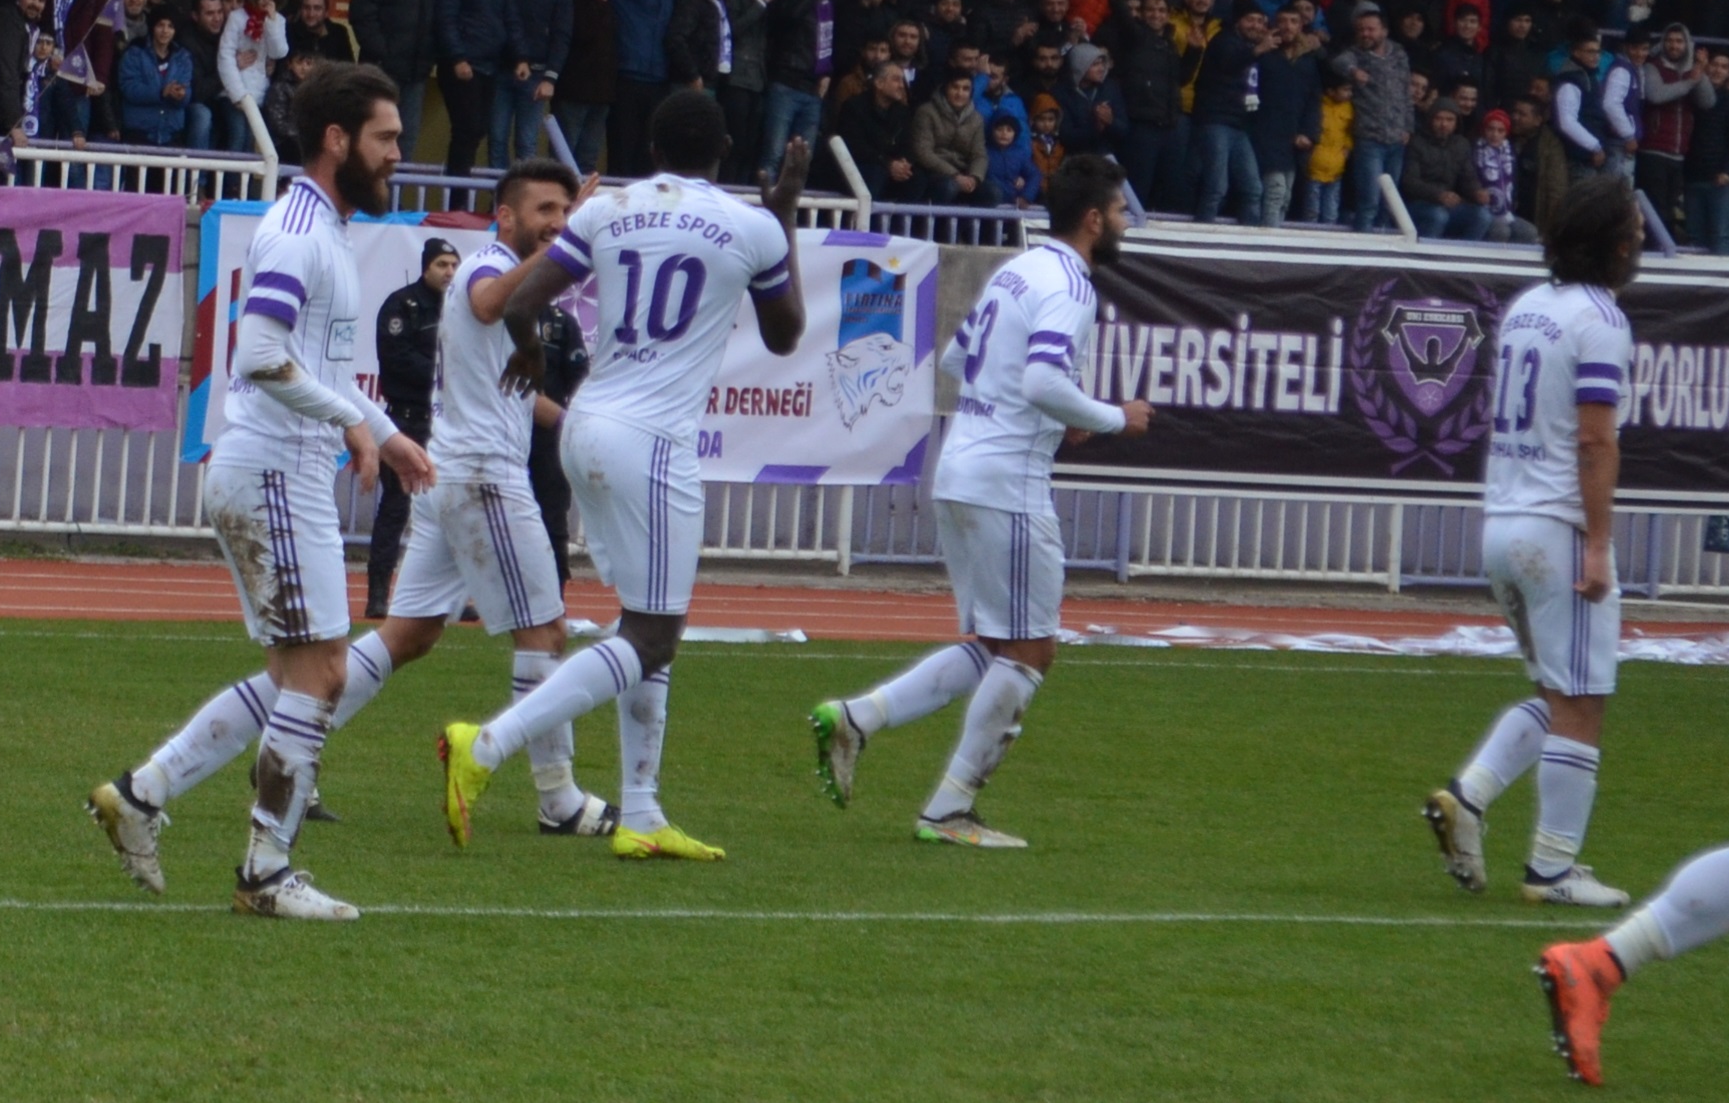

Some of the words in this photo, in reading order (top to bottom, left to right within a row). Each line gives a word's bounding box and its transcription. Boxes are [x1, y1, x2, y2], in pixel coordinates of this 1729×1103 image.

[610, 212, 671, 237] GEBZE
[676, 213, 733, 248] SPOR
[614, 249, 706, 343] 10
[724, 382, 812, 417] DERNEĞİ
[1080, 304, 1342, 413] NİVERSİTELİ
[1495, 344, 1541, 433] 13
